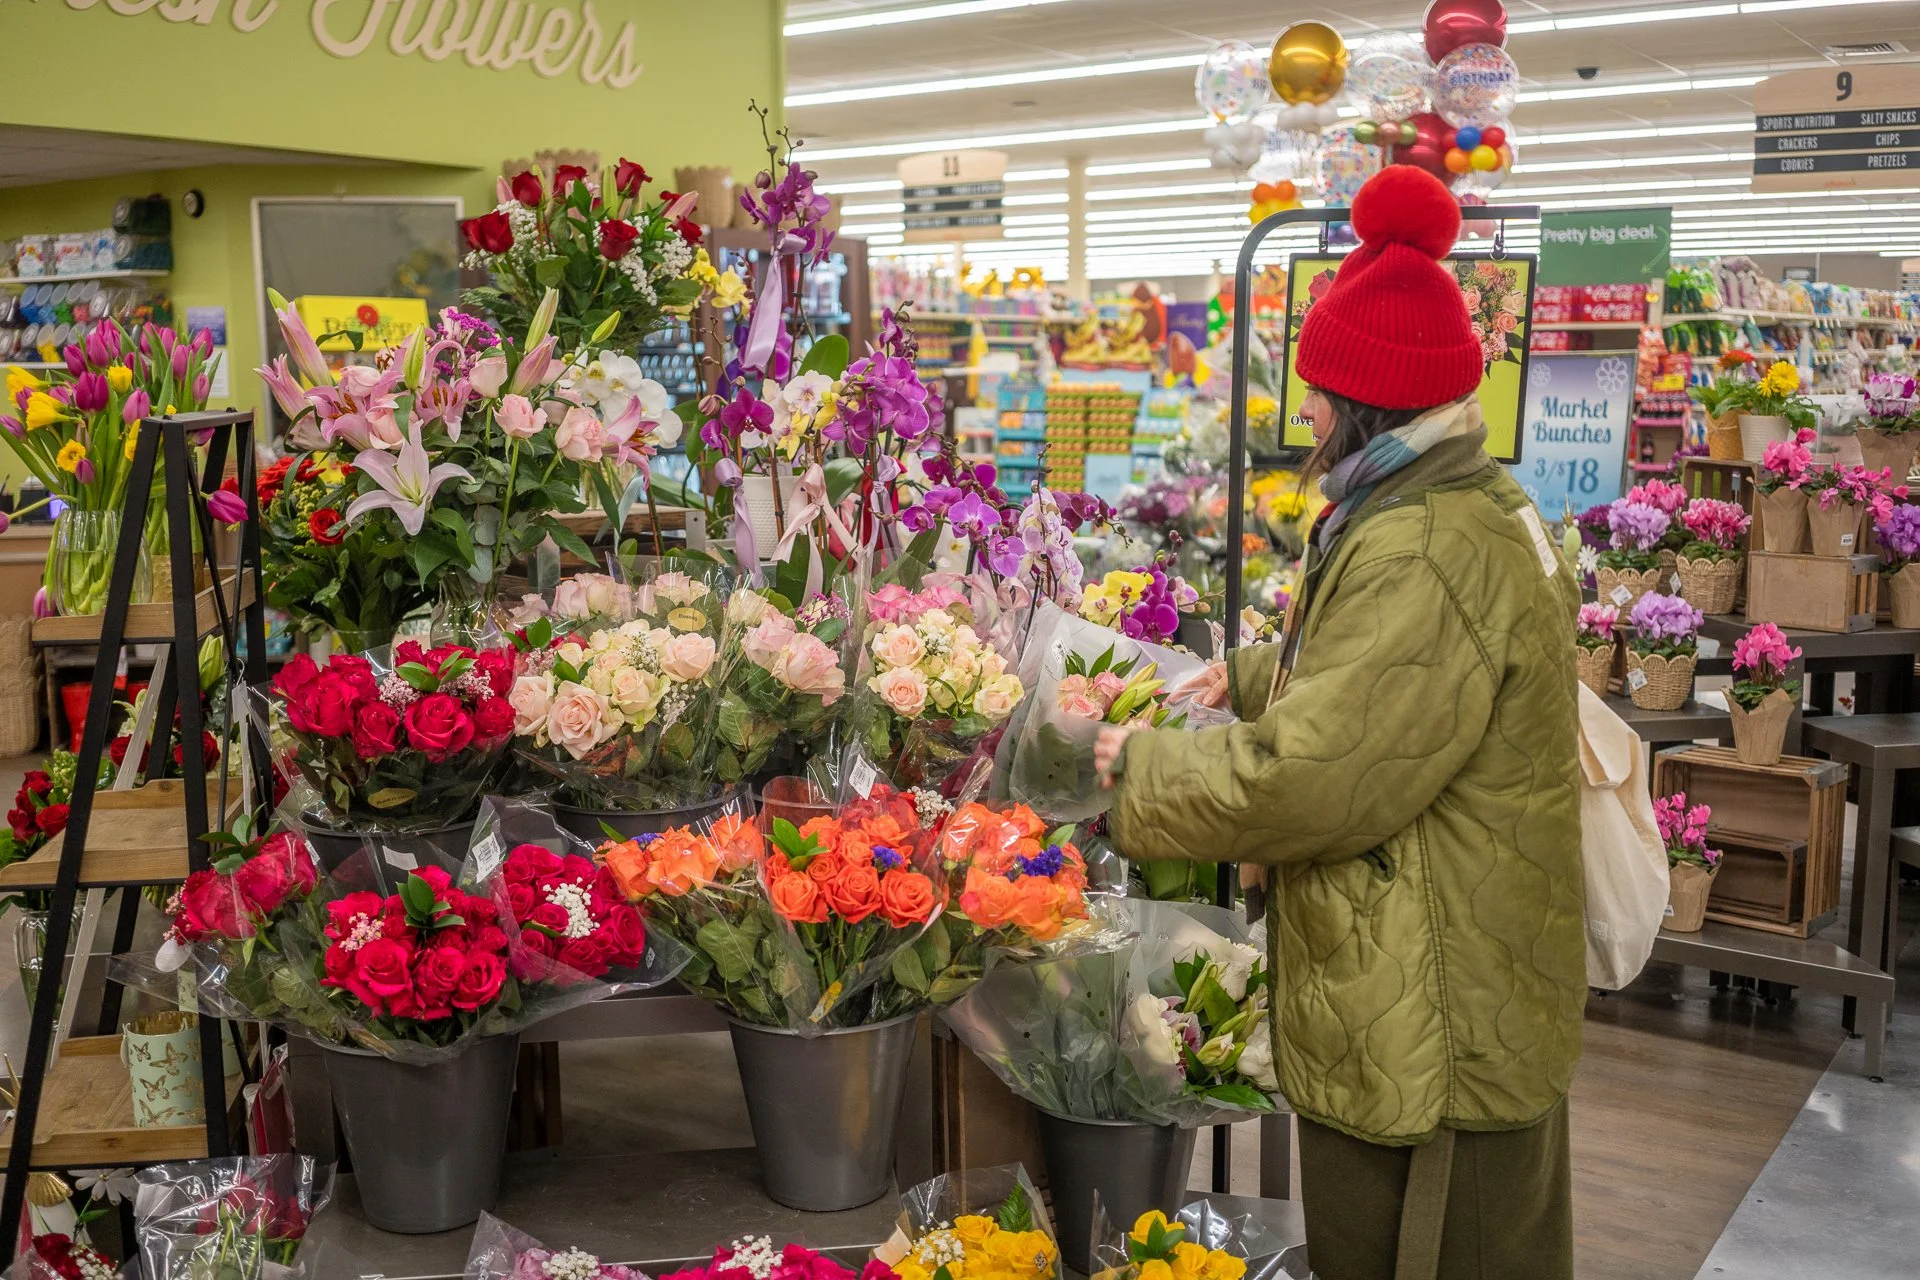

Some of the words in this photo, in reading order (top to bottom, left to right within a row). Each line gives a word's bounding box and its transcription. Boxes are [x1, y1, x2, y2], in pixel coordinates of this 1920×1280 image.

[1449, 72, 1512, 86] BIRTHDAY
[1836, 71, 1853, 101] 9
[1762, 116, 1793, 131] SPORTS
[1794, 114, 1836, 129] NUTRITION
[1861, 112, 1884, 125] SALTY
[1886, 110, 1917, 124] SNACKS
[1777, 136, 1818, 151] CRACKERS
[1875, 132, 1900, 146] CHIPS
[1780, 157, 1815, 172] COOKIES
[1867, 154, 1907, 168] PRETZELS
[1543, 227, 1587, 245] Pretty
[1590, 225, 1616, 244] big
[1618, 224, 1658, 241] deal.
[1541, 395, 1609, 419] Market
[1532, 420, 1612, 444] Bunches
